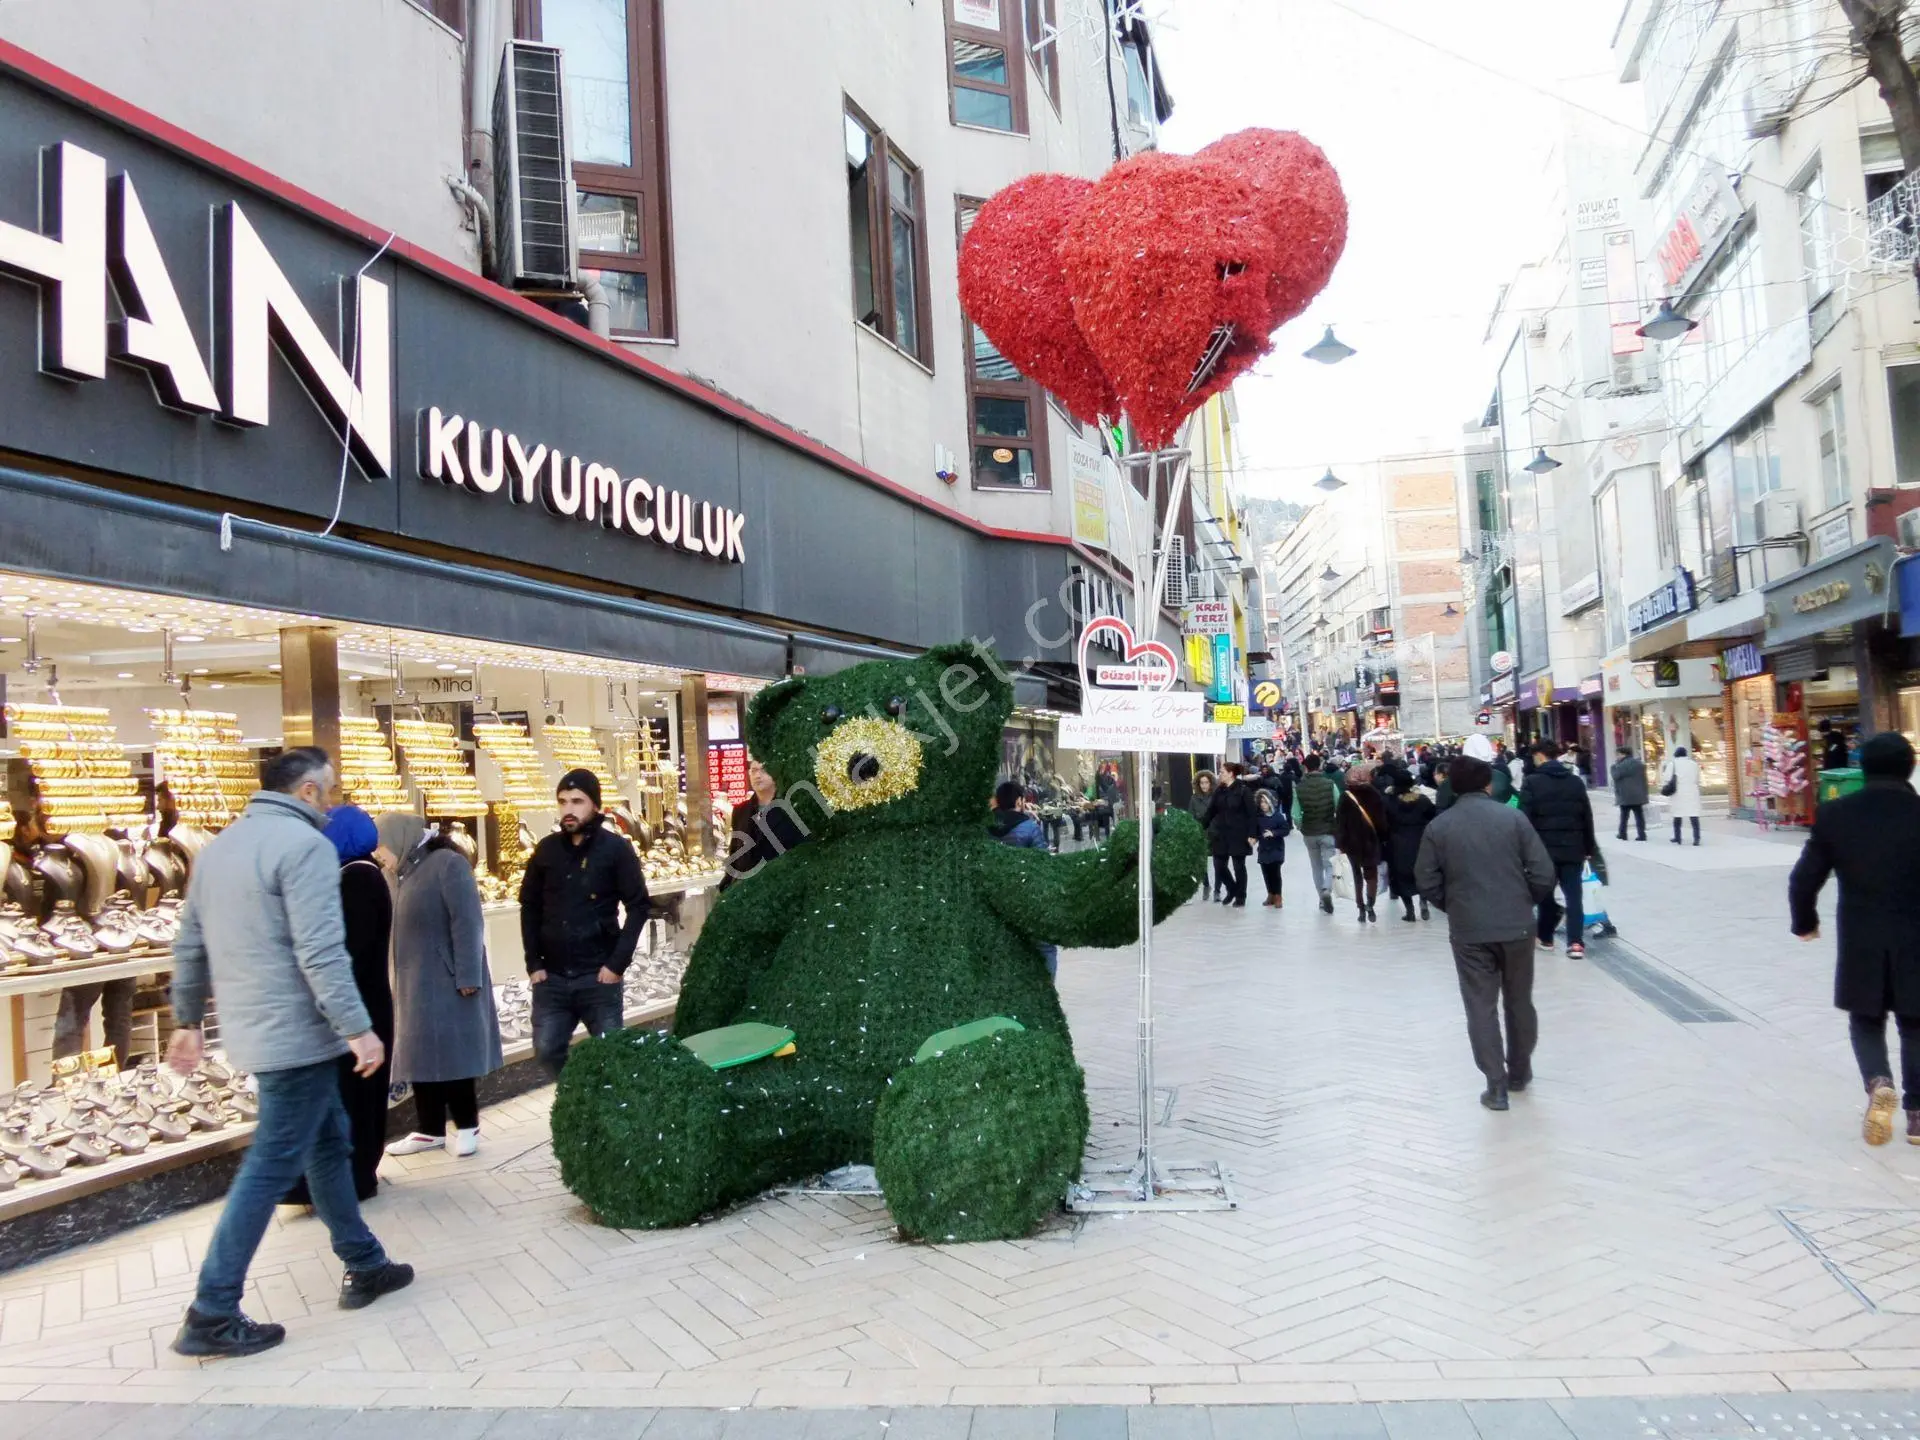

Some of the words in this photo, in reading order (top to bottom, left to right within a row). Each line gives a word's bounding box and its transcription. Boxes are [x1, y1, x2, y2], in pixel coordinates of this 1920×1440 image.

[1577, 198, 1618, 215] AVUKAT
[429, 406, 745, 563] KUYUMCULUK
[1196, 602, 1227, 611] KRAL
[1100, 670, 1136, 680] Güzel
[1115, 726, 1160, 736] KAPLAN
